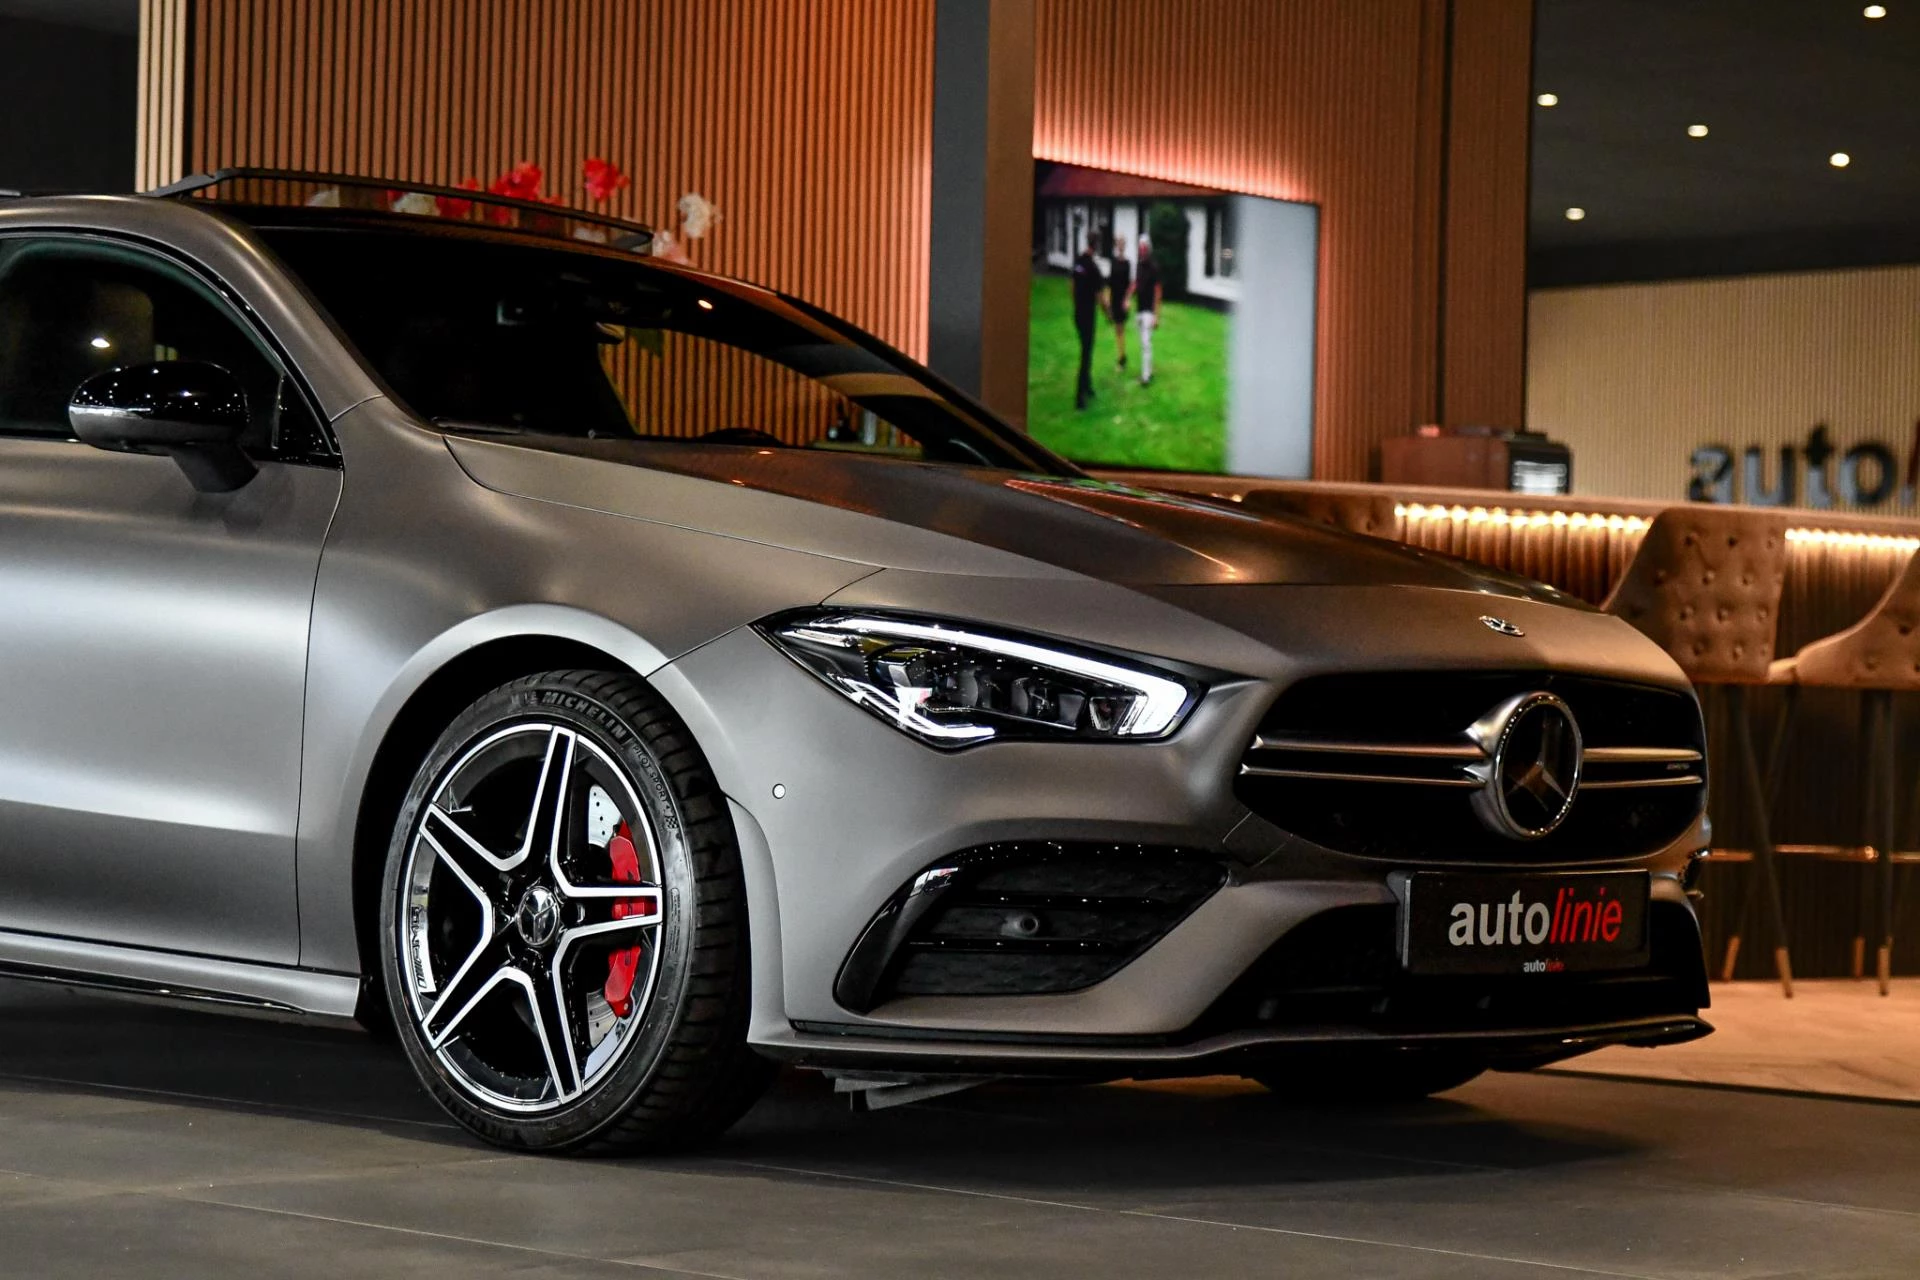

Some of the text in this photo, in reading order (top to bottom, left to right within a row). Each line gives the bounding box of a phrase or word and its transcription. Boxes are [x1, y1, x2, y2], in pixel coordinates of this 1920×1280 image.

[542, 691, 627, 739] MICHELIN
[632, 745, 651, 769] PILOT
[649, 772, 667, 802] SPORT
[1449, 887, 1622, 945] autolinie
